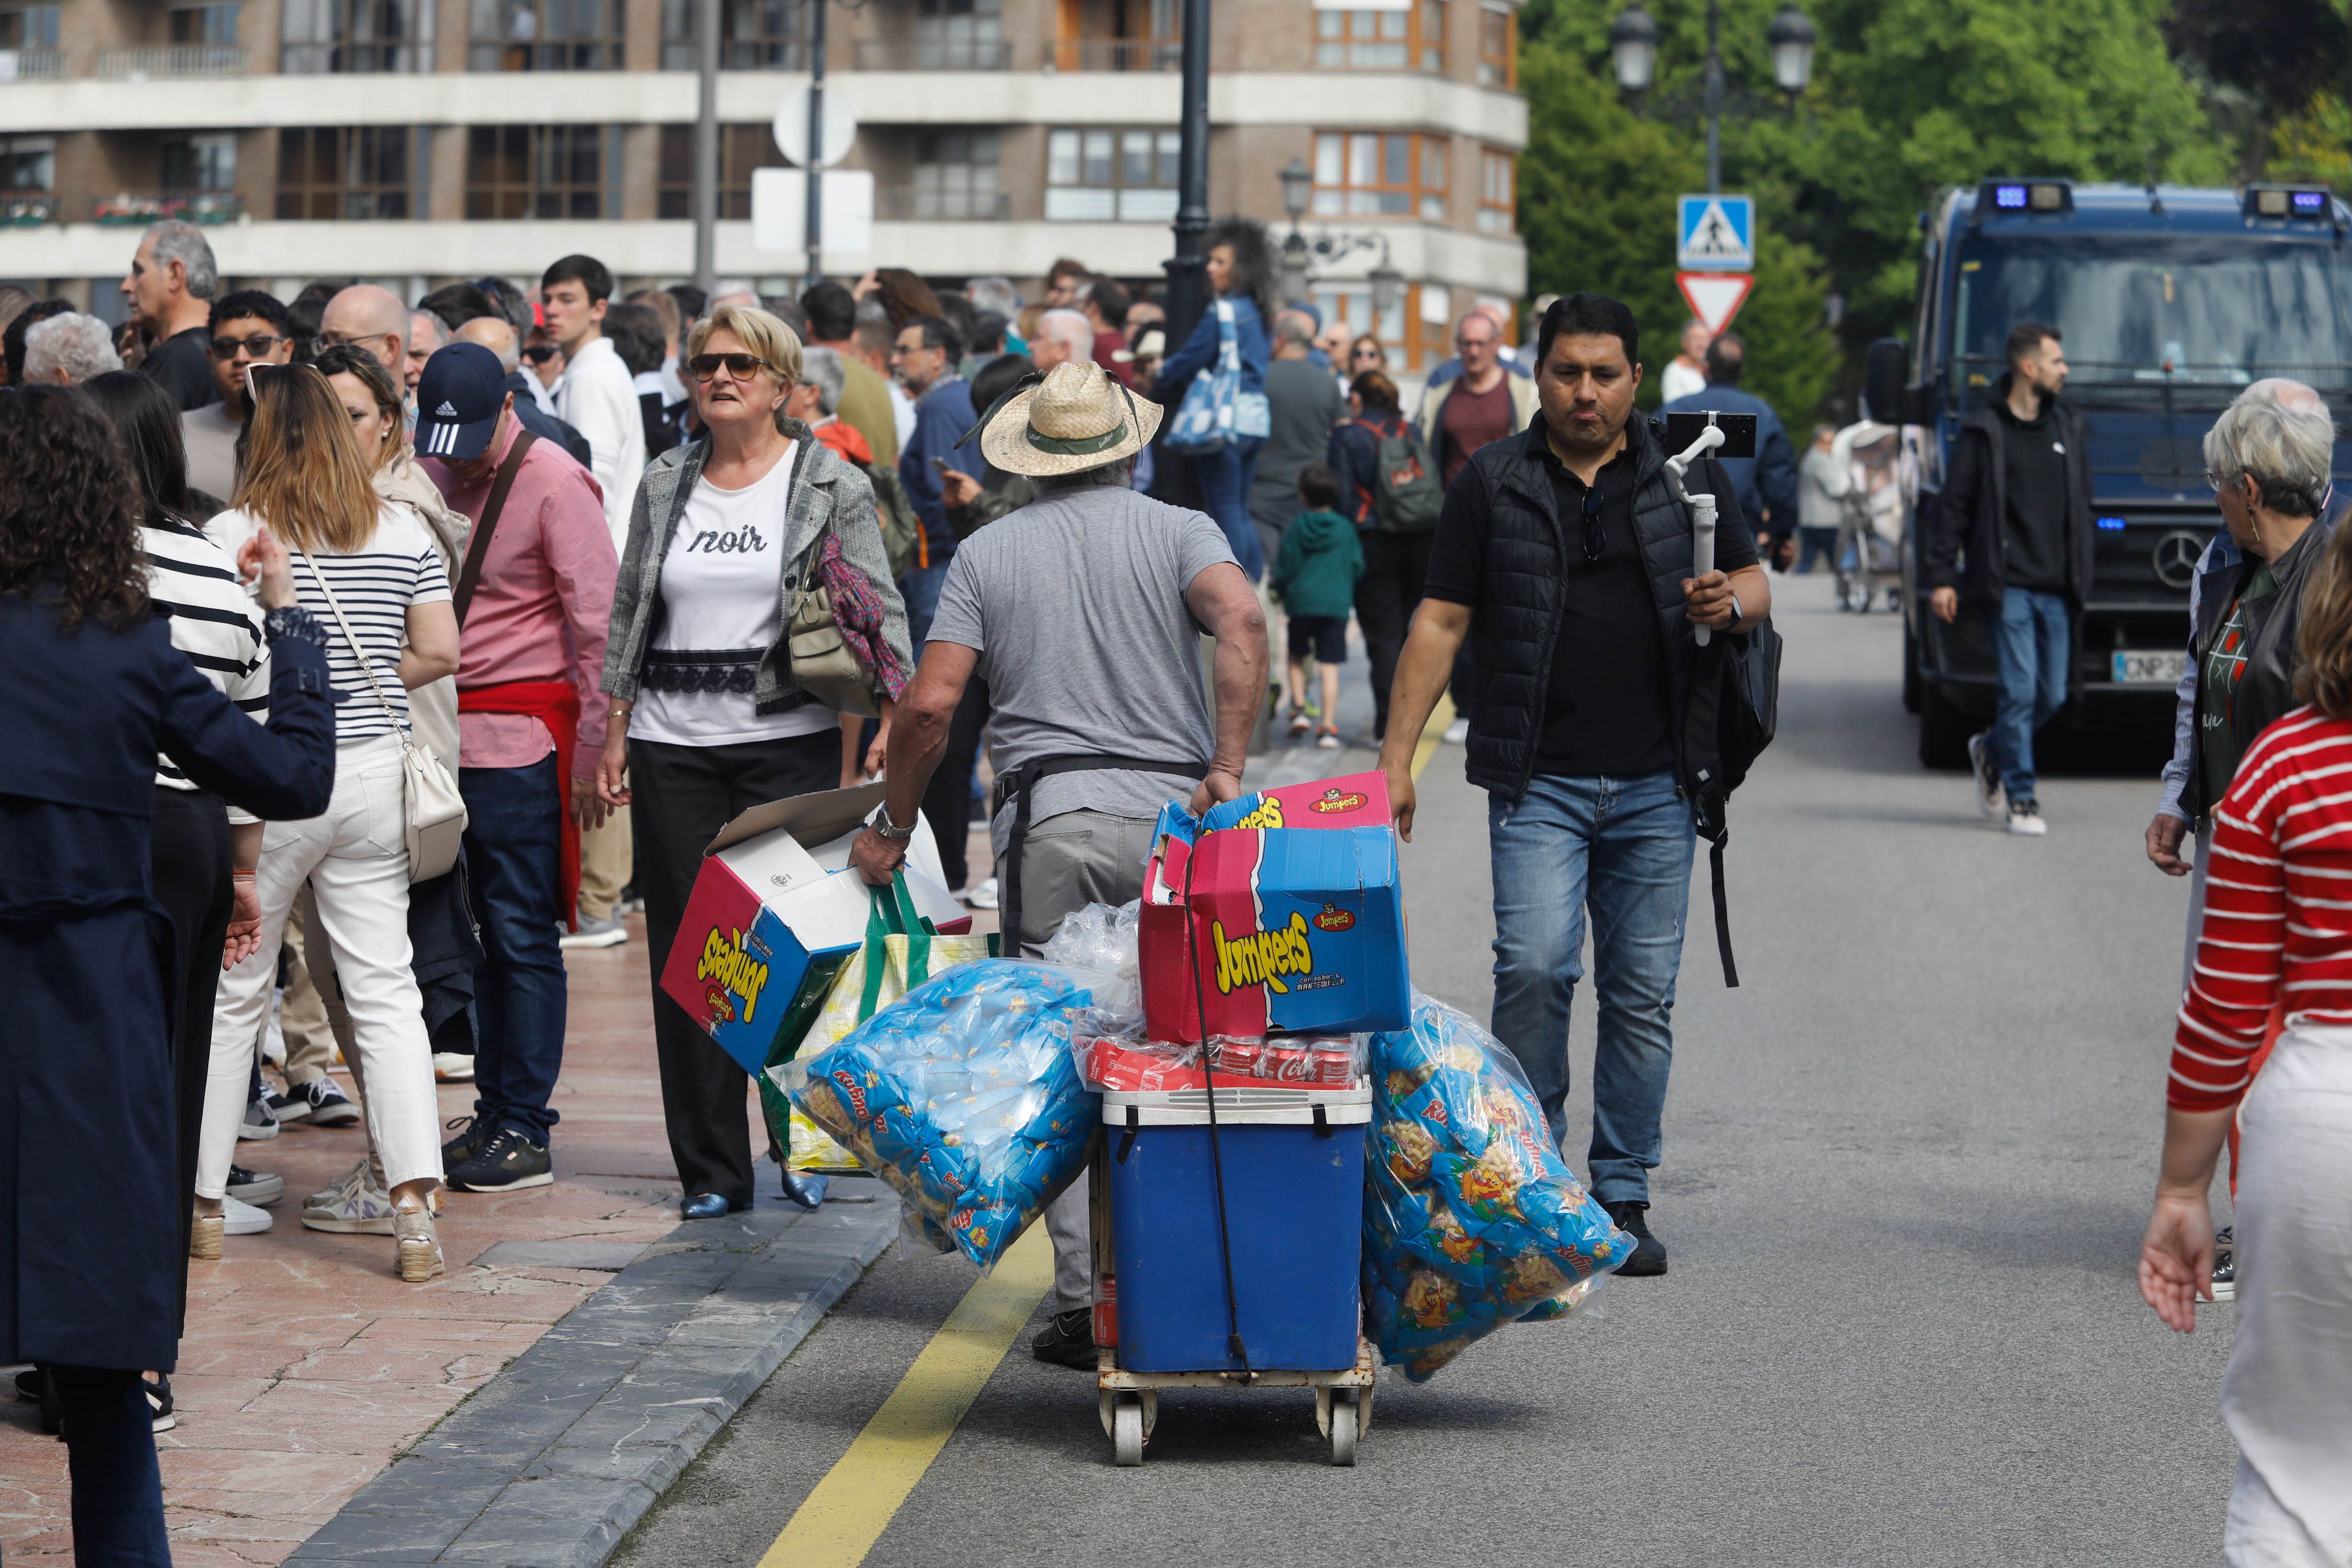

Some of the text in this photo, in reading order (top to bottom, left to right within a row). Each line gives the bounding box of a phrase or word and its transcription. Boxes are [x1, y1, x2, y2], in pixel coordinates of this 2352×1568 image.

[687, 524, 767, 554] noir
[1320, 795, 1359, 812] Jumpers
[1320, 912, 1349, 928] Jumpers
[1213, 912, 1312, 995] Jumpers
[697, 927, 768, 1023] Jumpers
[1297, 978, 1345, 991] MANTEQUILLA
[709, 993, 732, 1019] Jumpers
